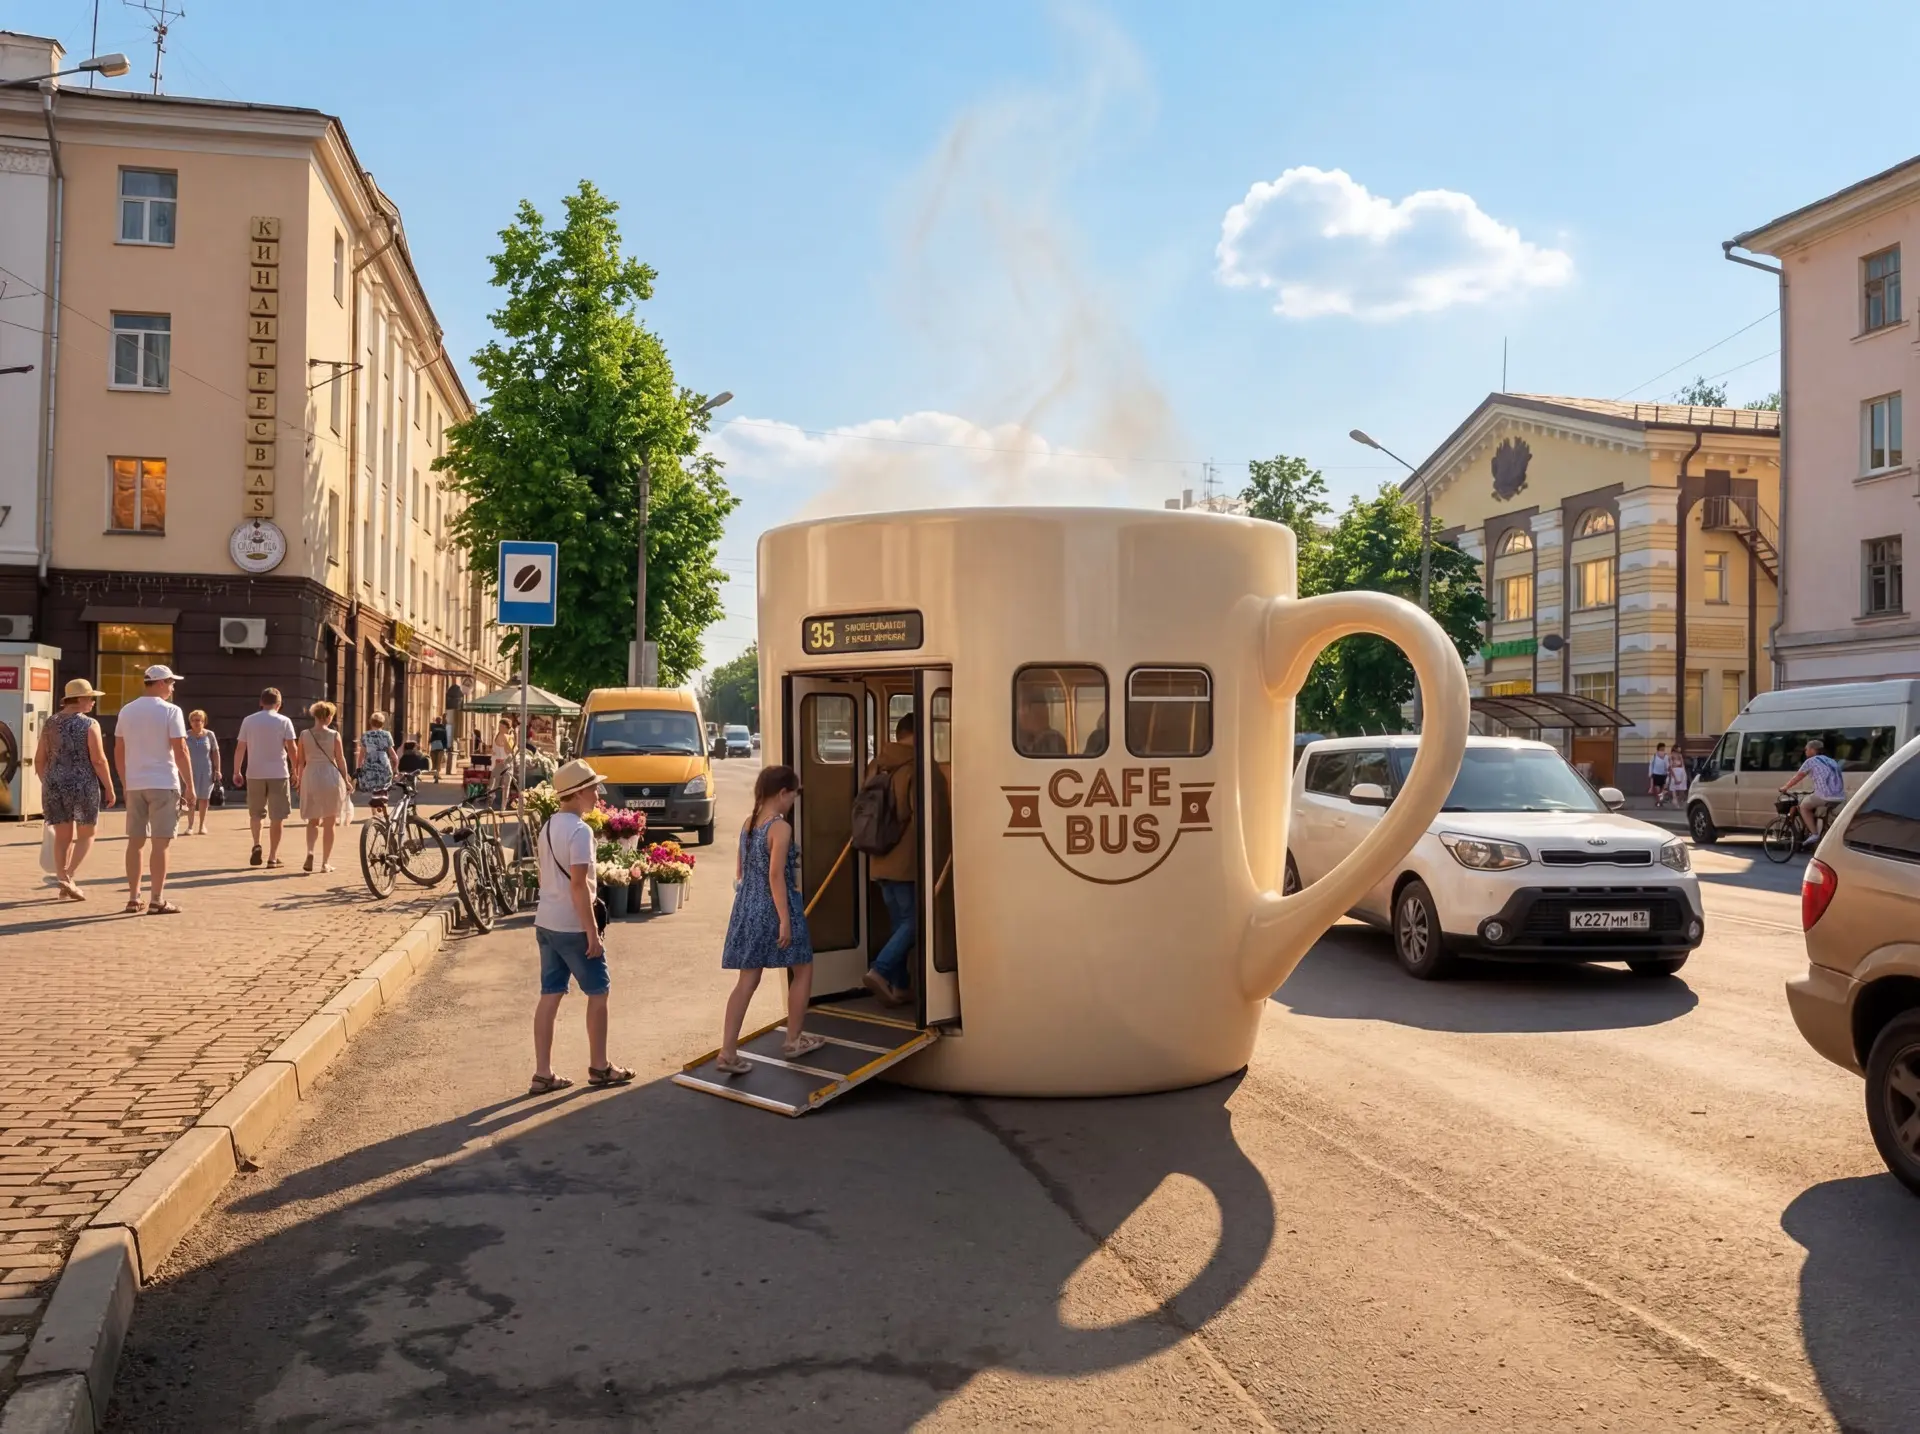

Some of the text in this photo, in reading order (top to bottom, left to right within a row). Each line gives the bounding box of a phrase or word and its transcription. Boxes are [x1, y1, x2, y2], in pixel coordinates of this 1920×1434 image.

[810, 621, 835, 649] 35
[1048, 767, 1171, 808] CAFE
[1066, 813, 1161, 855] BUS
